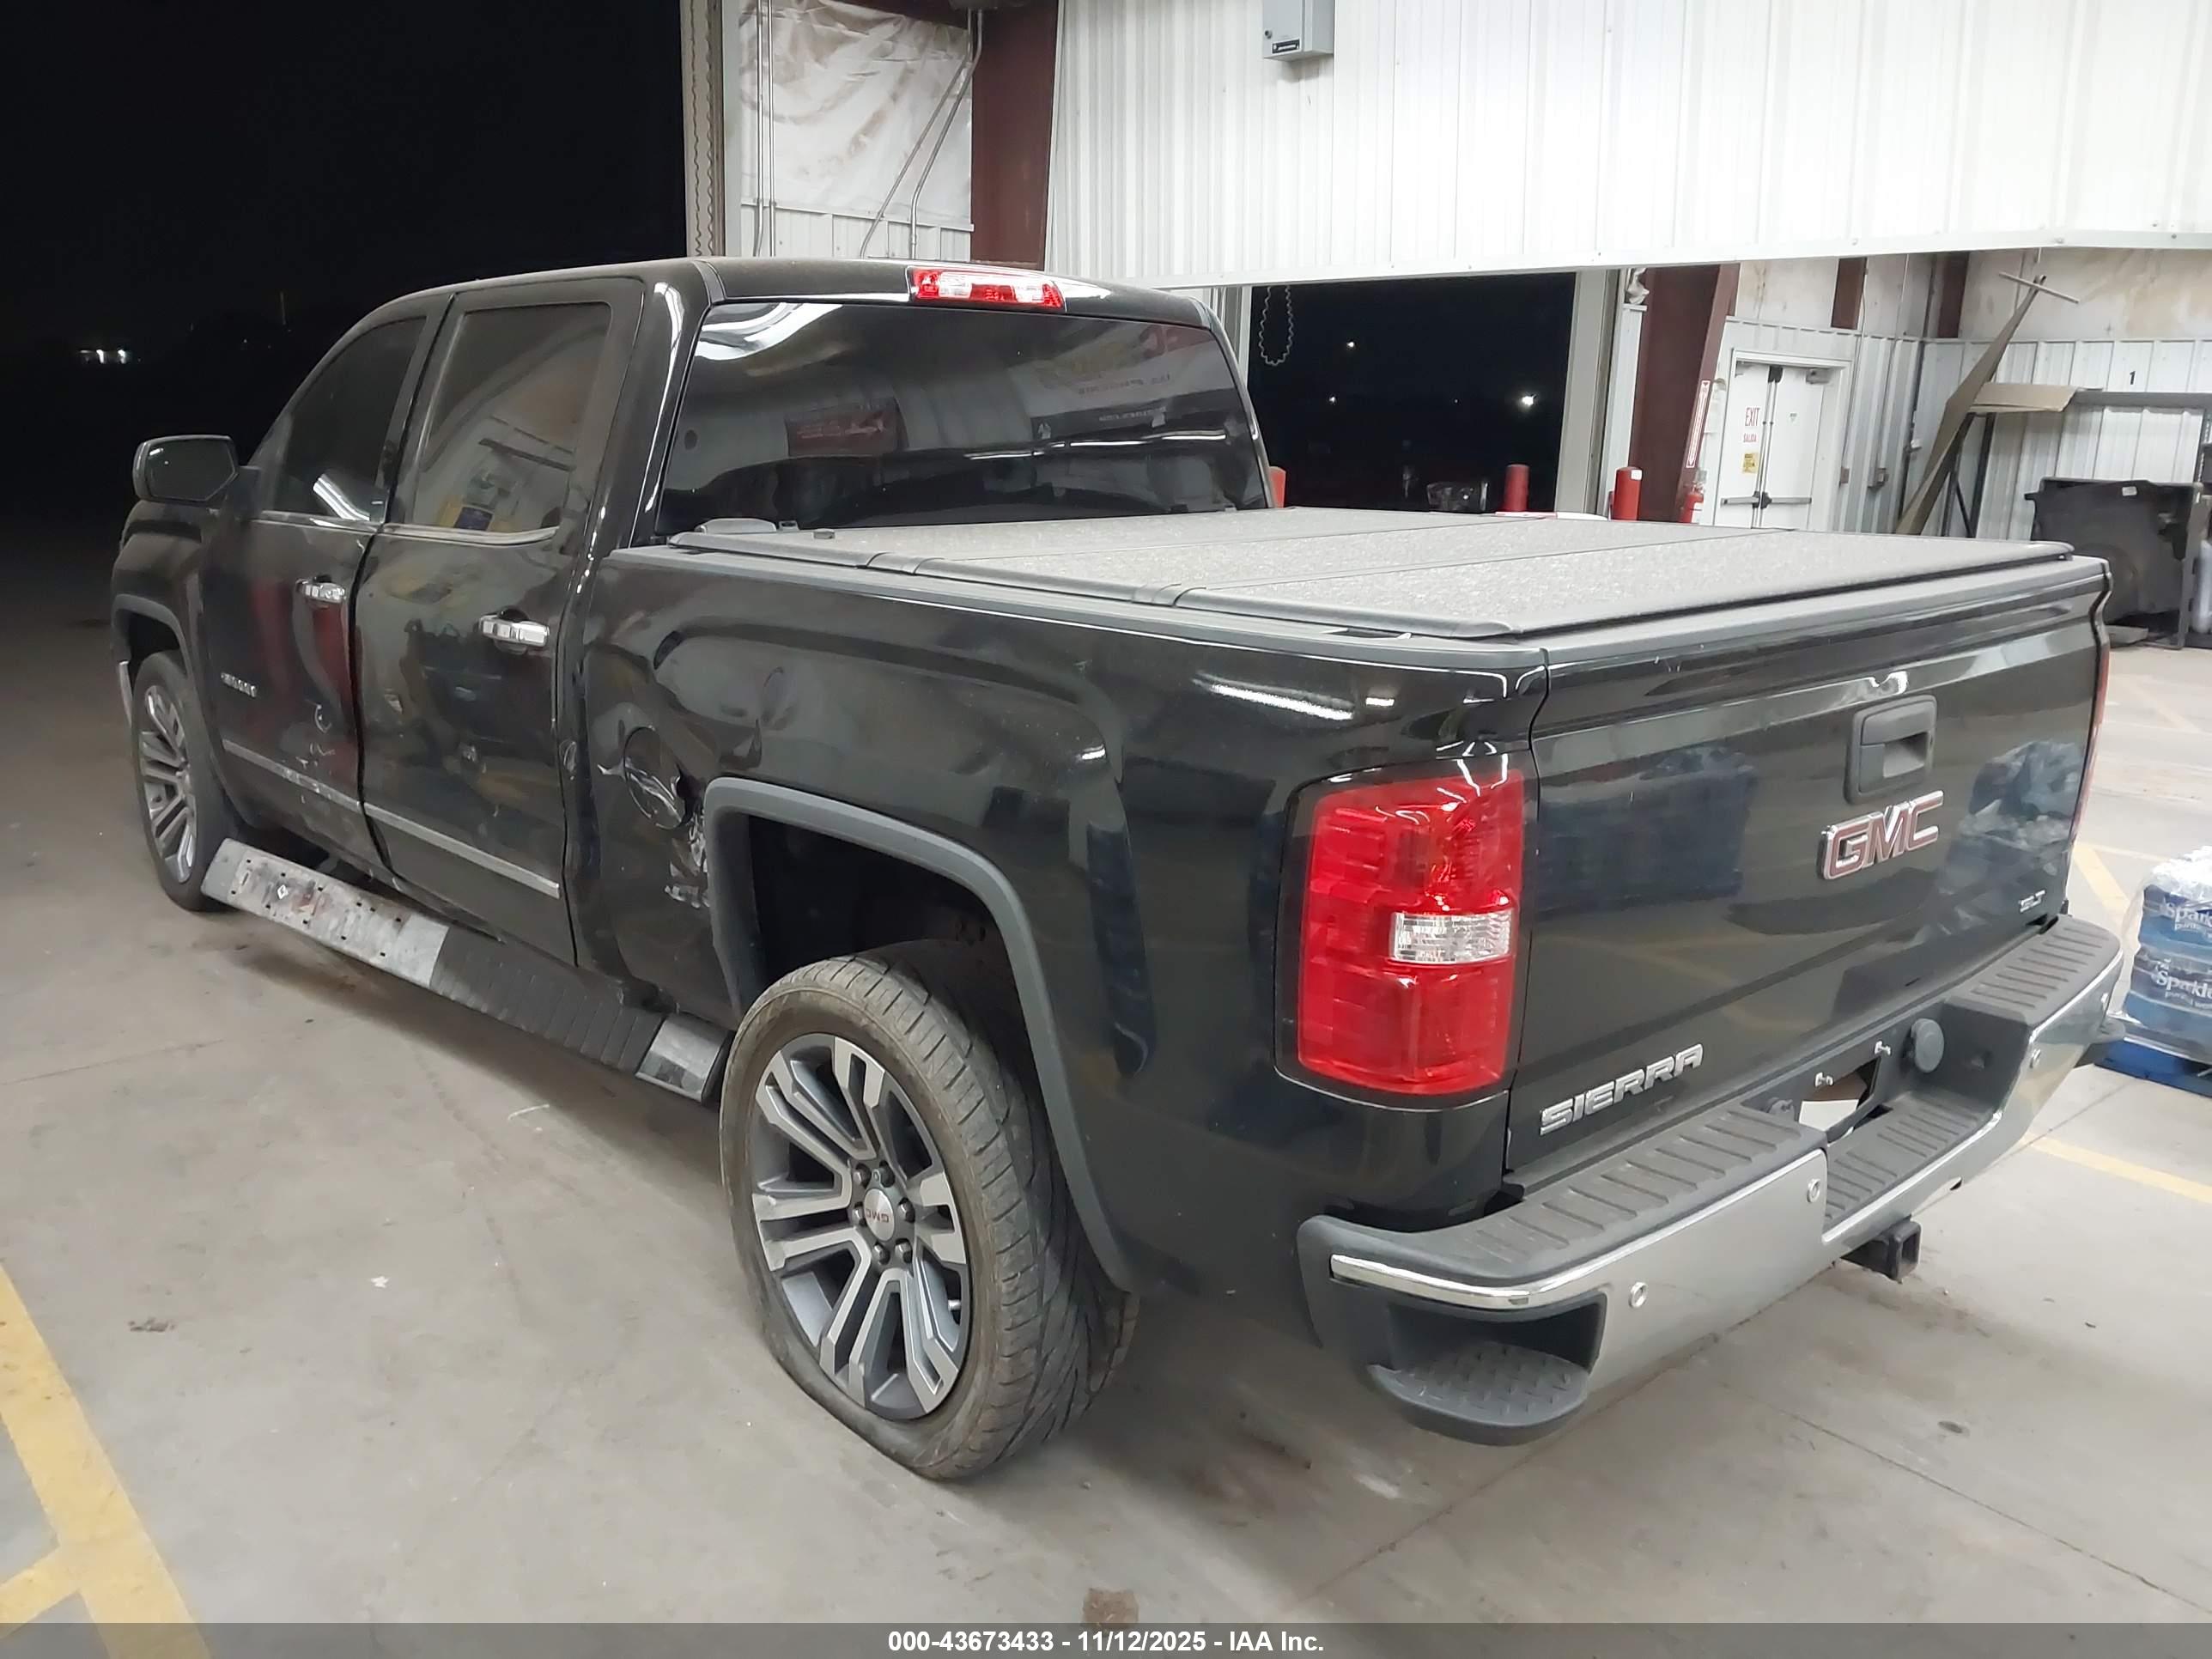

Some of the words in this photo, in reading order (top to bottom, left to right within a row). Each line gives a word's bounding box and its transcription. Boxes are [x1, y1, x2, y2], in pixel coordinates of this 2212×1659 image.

[2129, 370, 2136, 386] 1
[1744, 407, 1760, 427] EXIT
[1742, 432, 1757, 443] SALIDA
[1820, 789, 1944, 880] GMC
[1539, 1042, 1704, 1136] SIERRA
[866, 1207, 890, 1223] GMC
